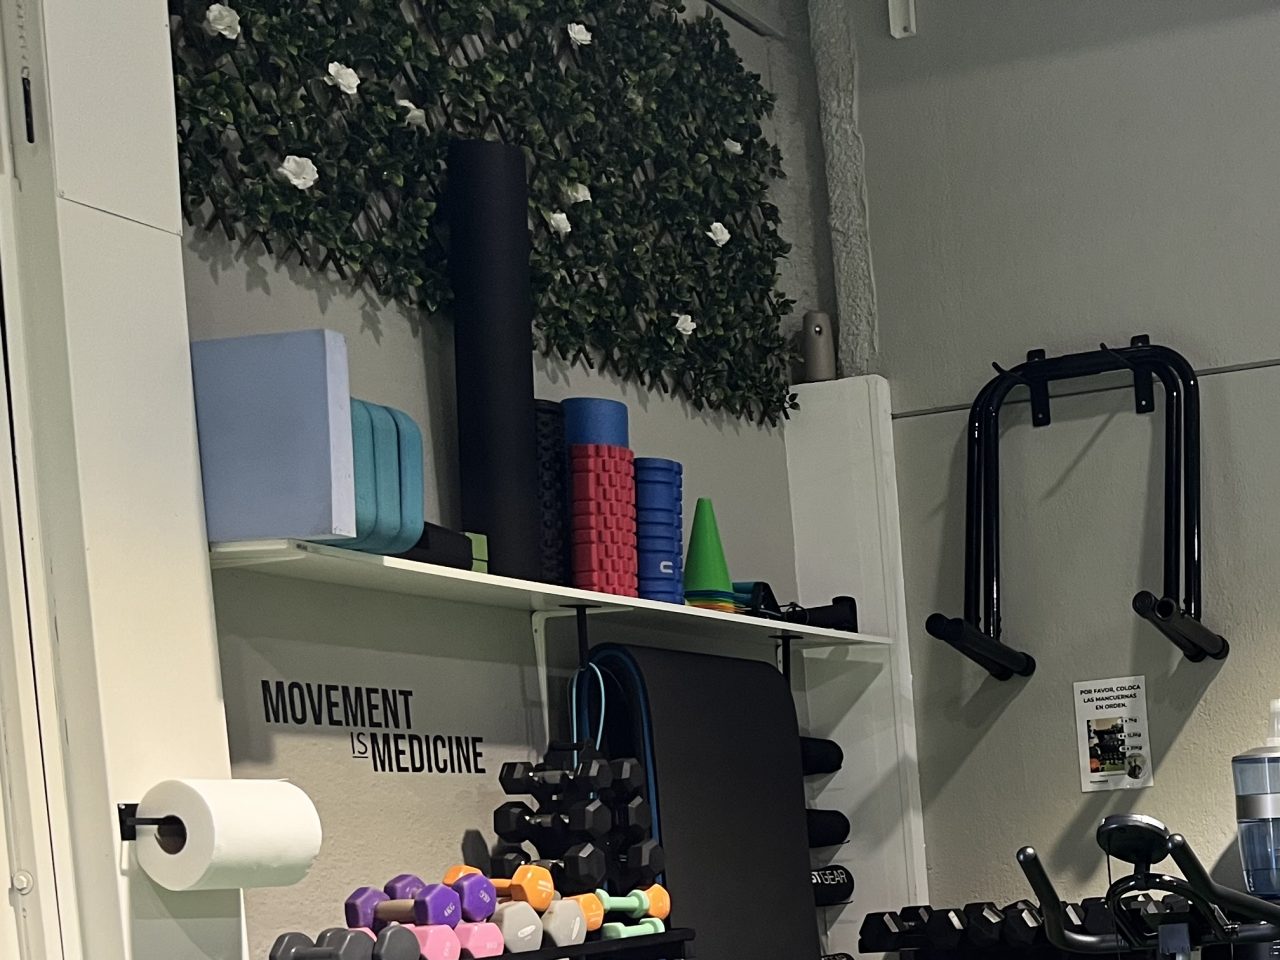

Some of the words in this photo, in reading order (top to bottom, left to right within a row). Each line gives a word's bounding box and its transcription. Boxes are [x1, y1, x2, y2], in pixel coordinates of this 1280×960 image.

[1095, 693, 1137, 702] MANCUERNAS
[1116, 684, 1141, 692] COLOCA
[261, 679, 413, 730] MOVEMENT
[350, 731, 369, 758] IS
[369, 732, 486, 774] MEDICINE
